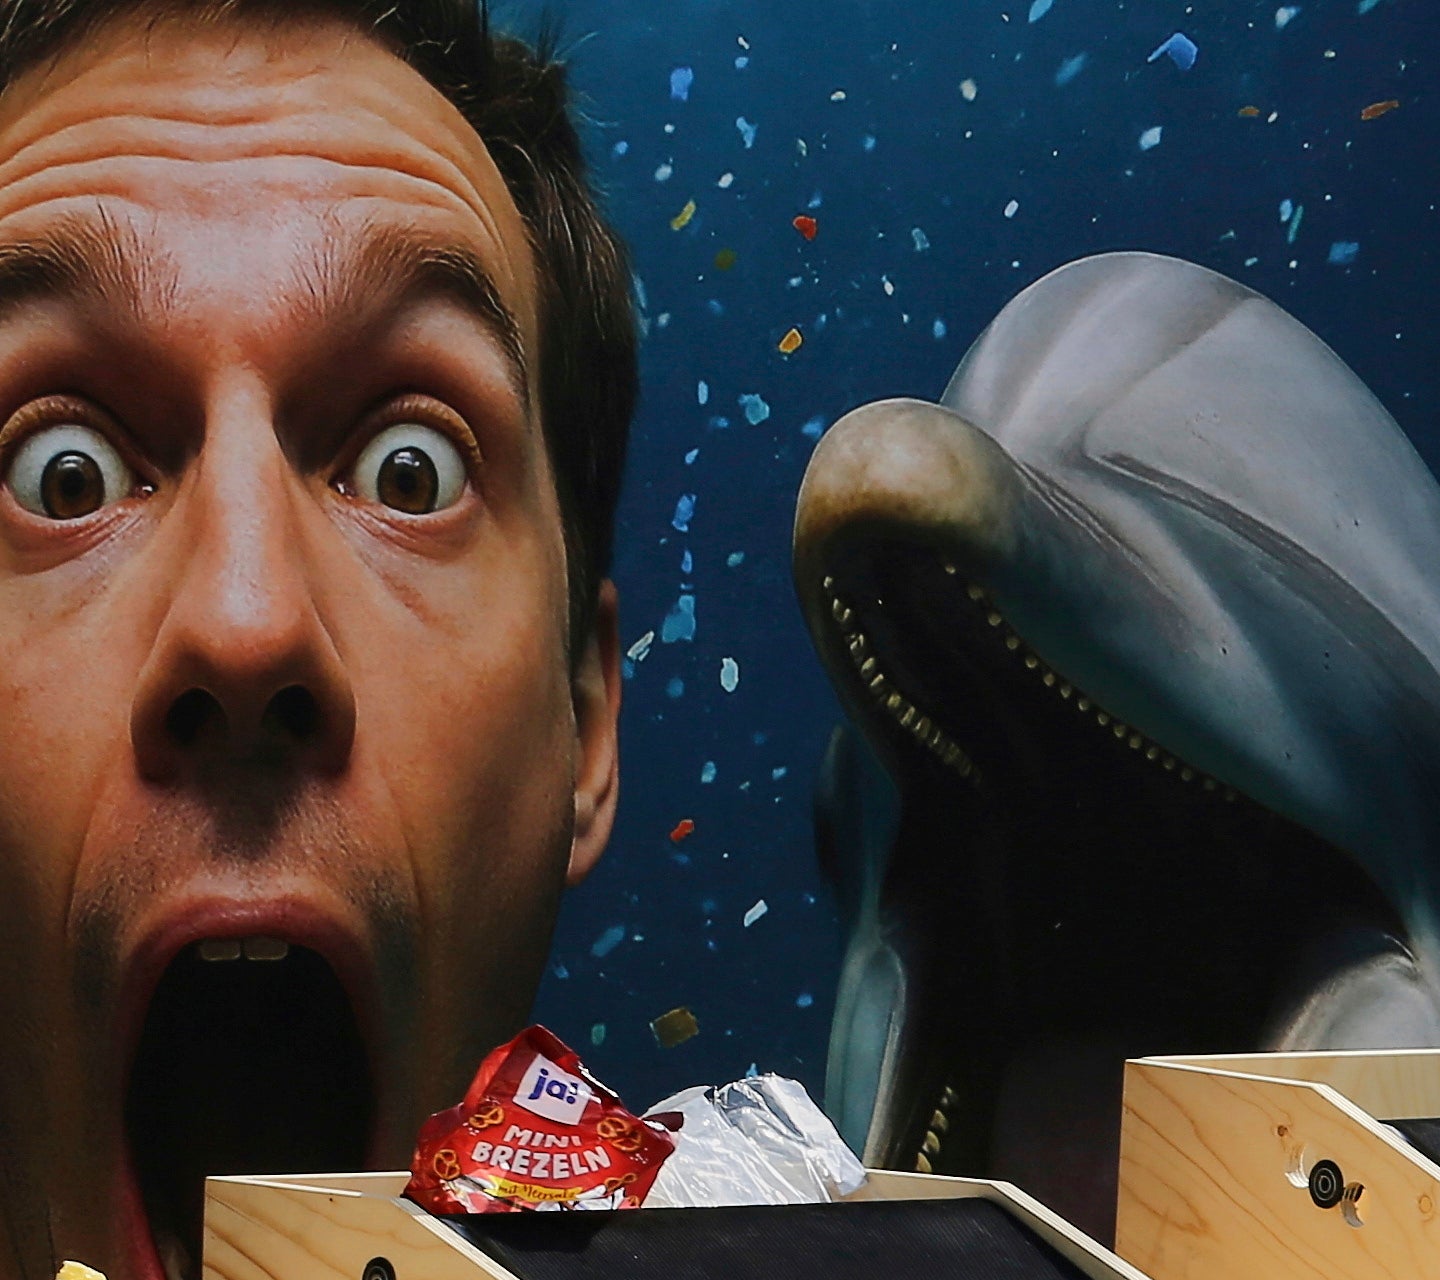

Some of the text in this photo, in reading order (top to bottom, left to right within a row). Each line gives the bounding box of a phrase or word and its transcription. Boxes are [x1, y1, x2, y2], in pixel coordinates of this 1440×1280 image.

[528, 1067, 578, 1105] ja!
[503, 1124, 582, 1148] MINI
[471, 1141, 612, 1180] BREZELN
